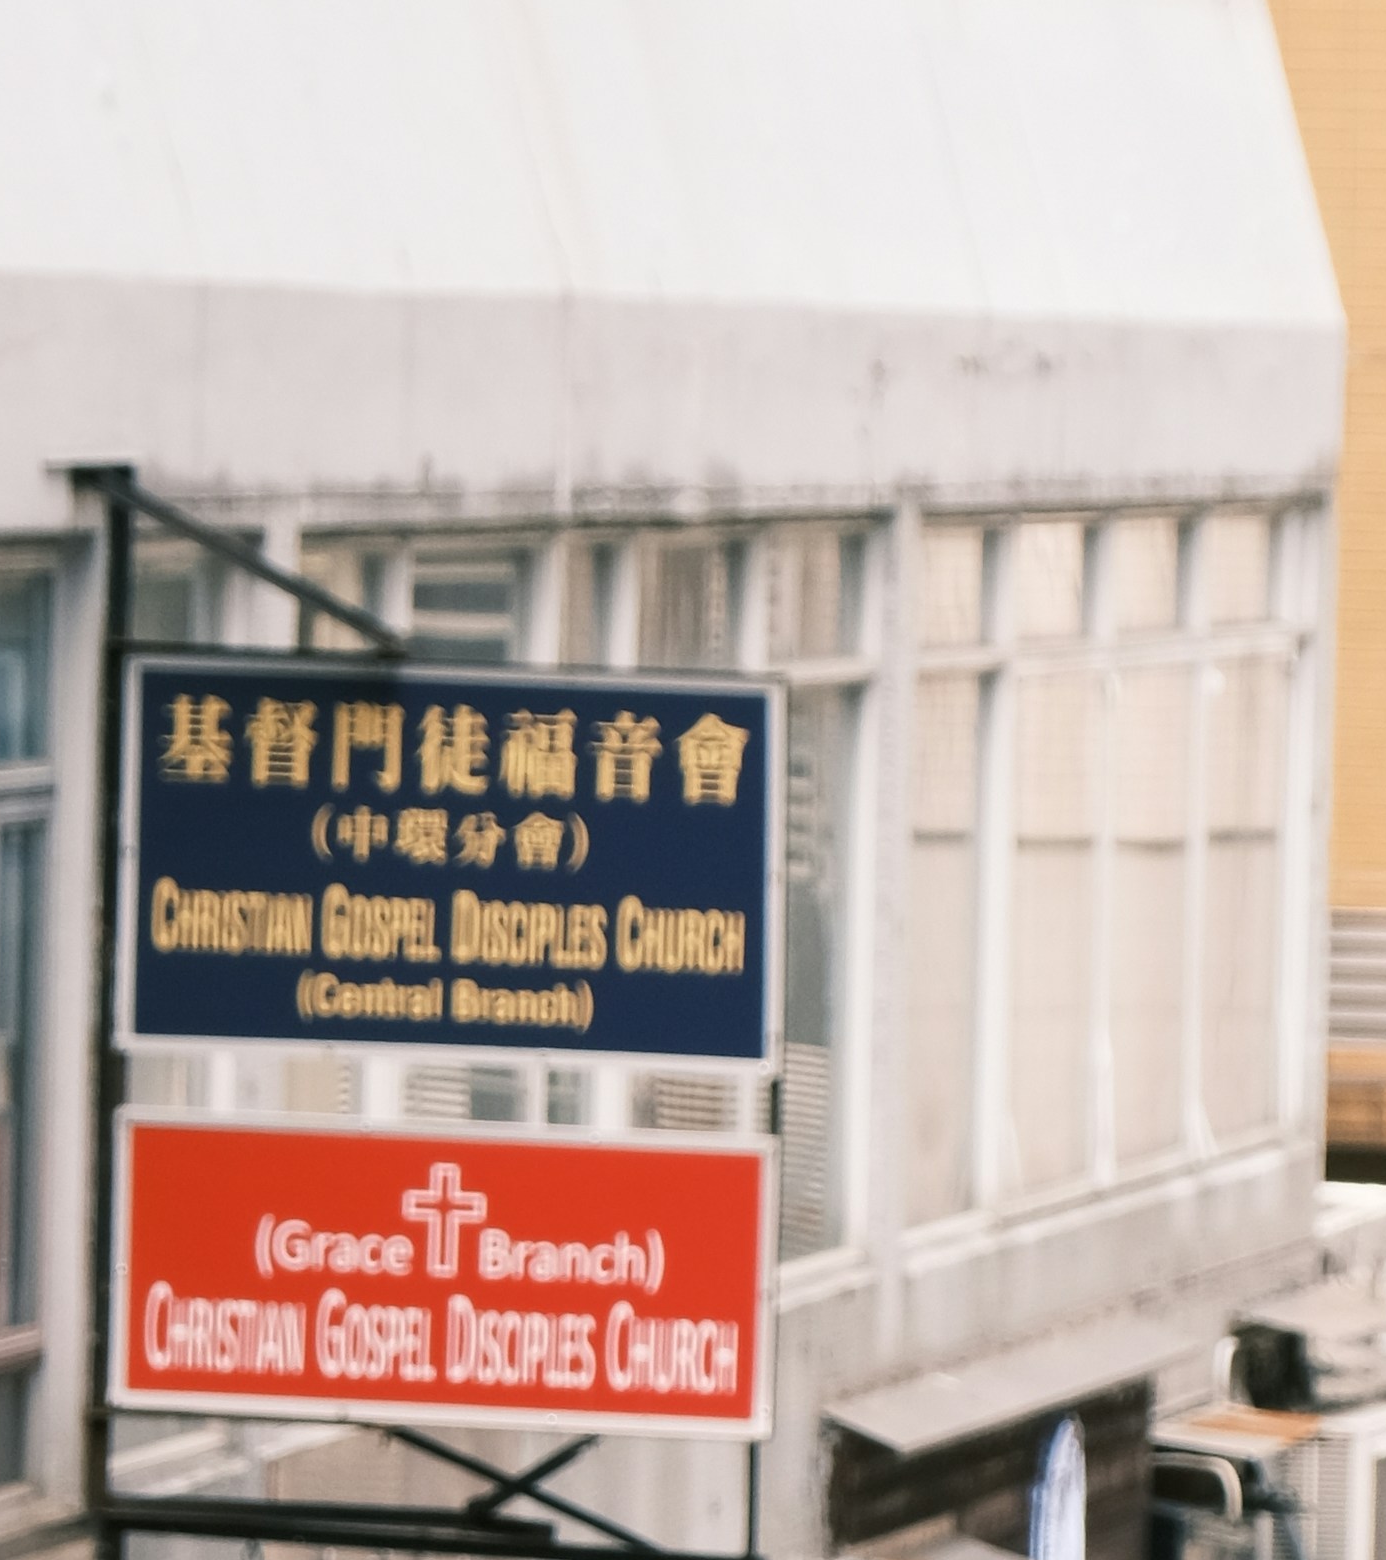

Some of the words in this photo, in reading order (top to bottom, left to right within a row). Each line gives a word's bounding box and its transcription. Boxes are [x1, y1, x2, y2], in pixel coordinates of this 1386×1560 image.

[159, 693, 751, 807] 基督門徒福音會
[296, 968, 444, 1022] (Central
[450, 977, 594, 1034] Branch)
[256, 1213, 413, 1279] (Grace
[478, 1228, 665, 1292] Branch)
